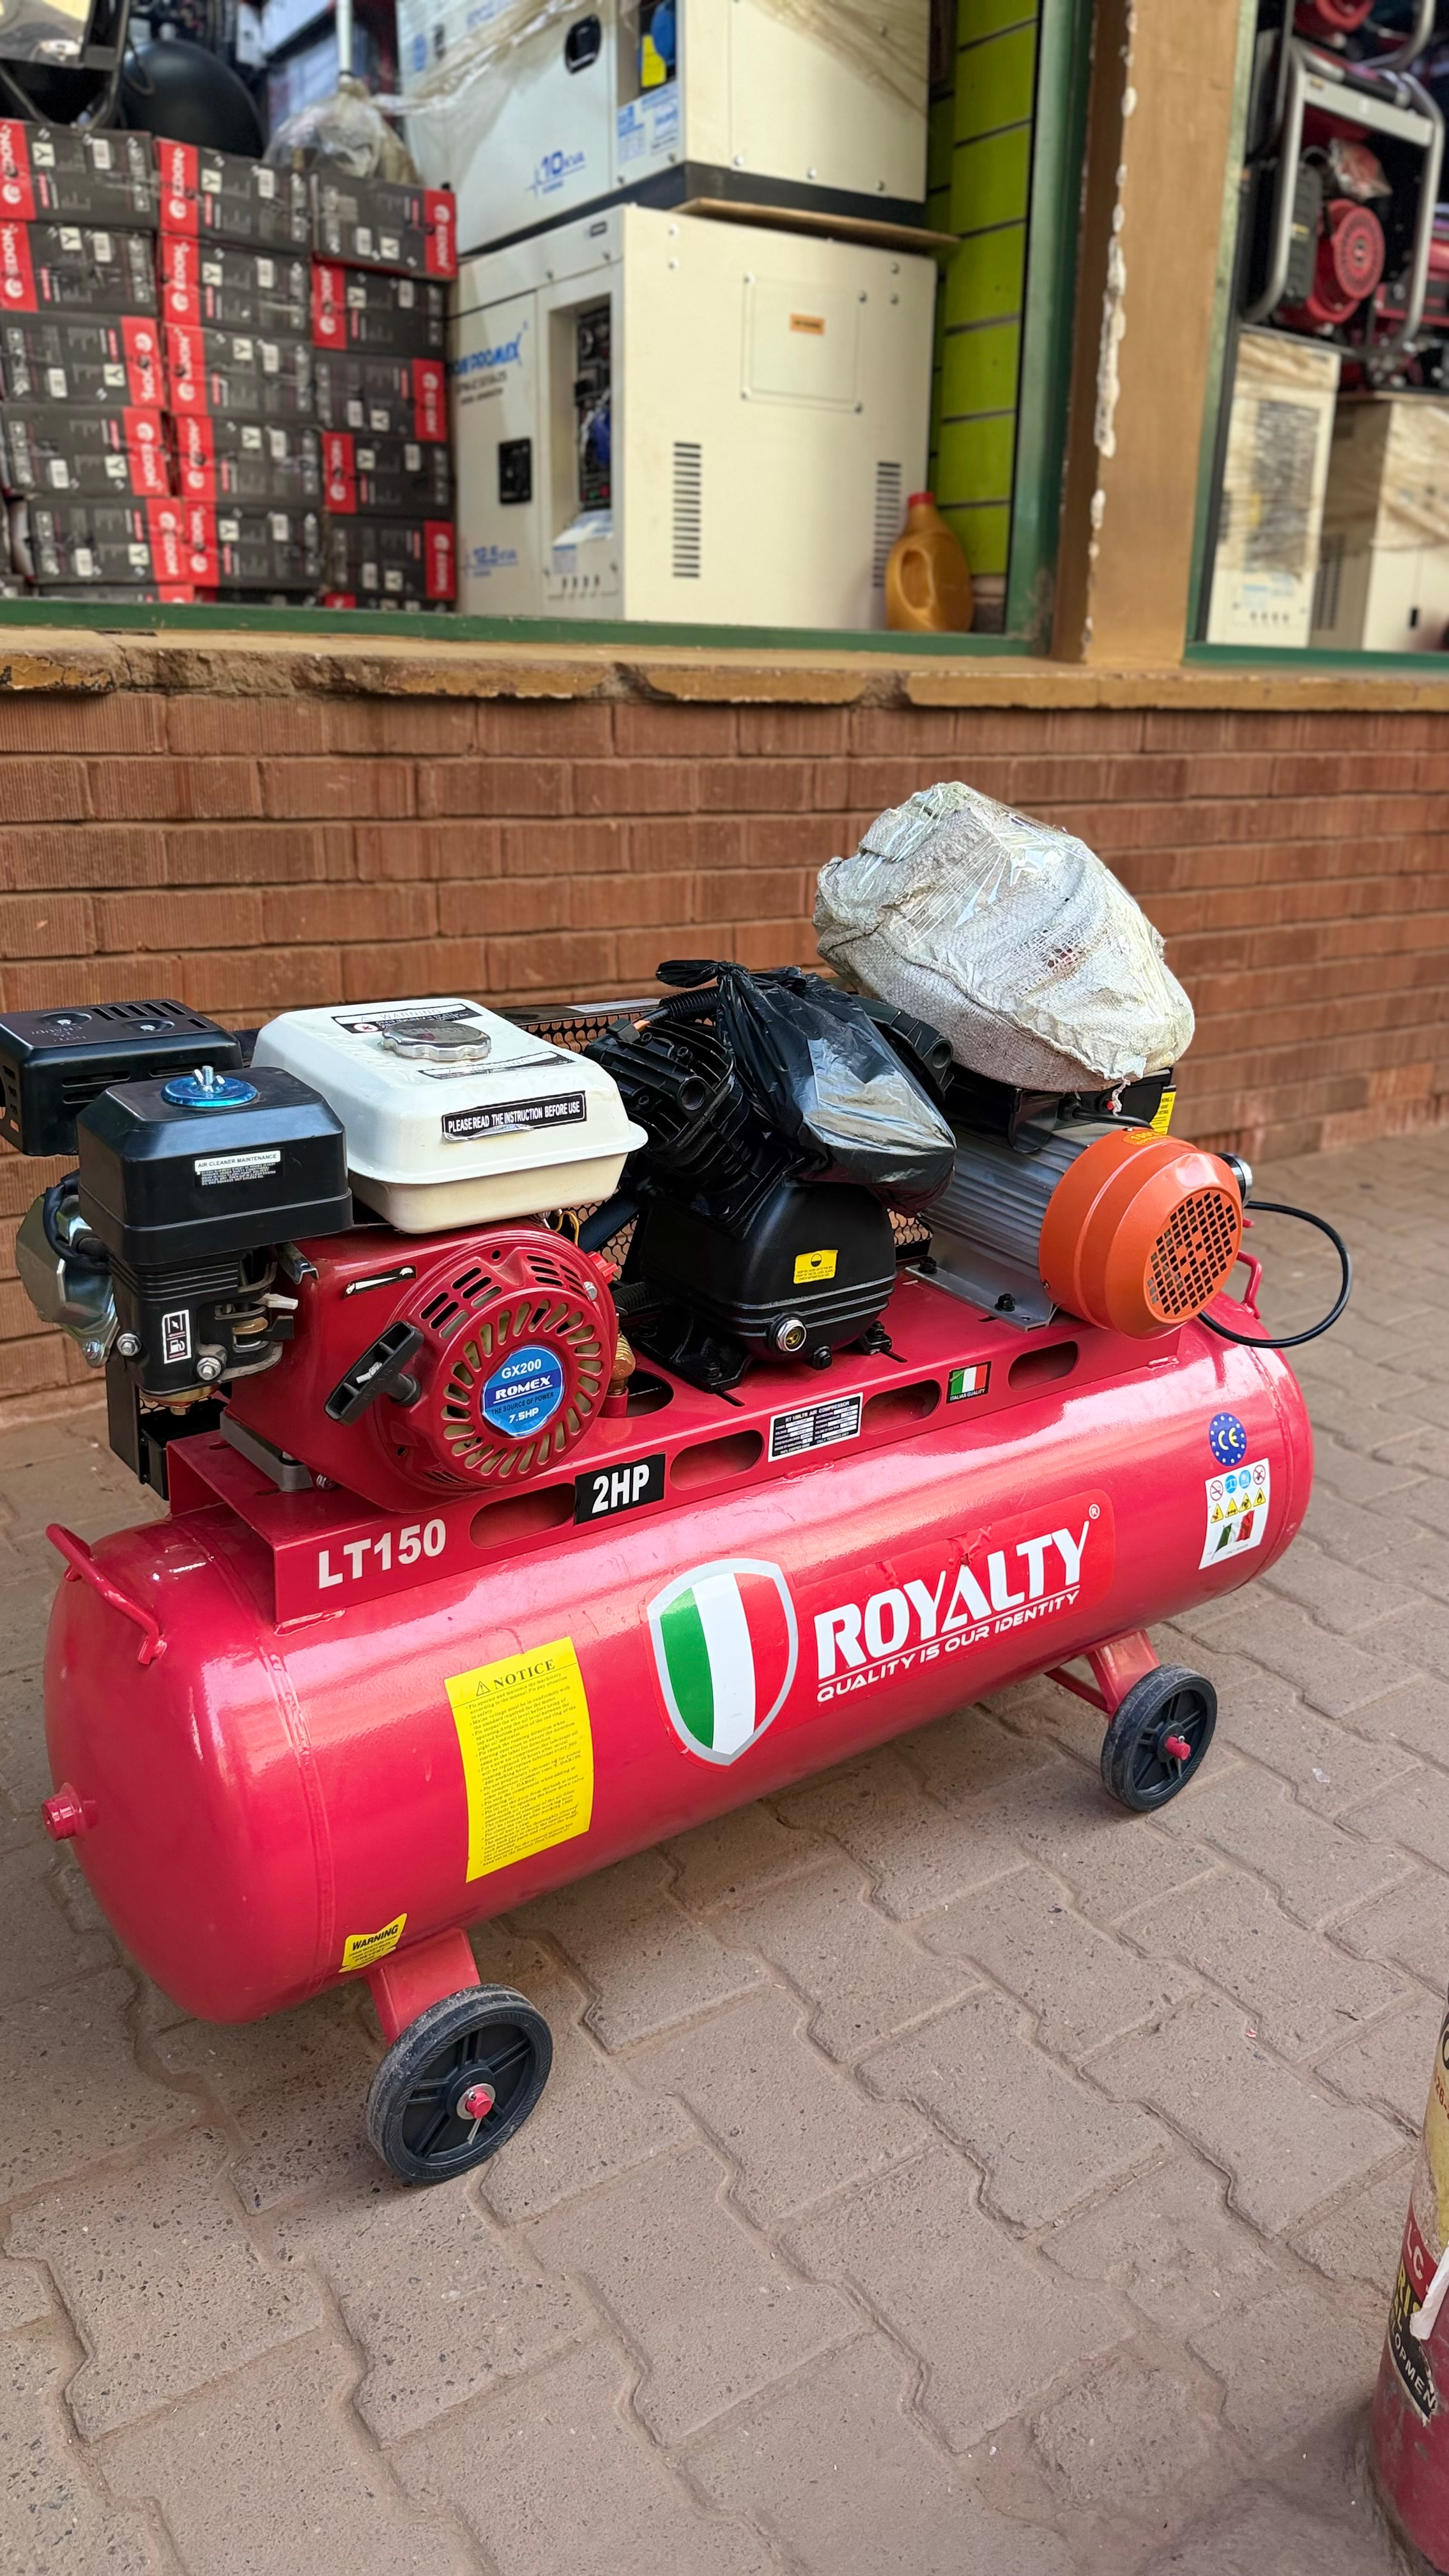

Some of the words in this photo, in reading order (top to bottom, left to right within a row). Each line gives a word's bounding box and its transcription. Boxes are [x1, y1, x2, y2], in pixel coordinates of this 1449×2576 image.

[379, 1008, 442, 1020] WARNING
[448, 1117, 472, 1133] PLEASE
[473, 1115, 489, 1129] READ
[491, 1112, 503, 1126] THE
[504, 1107, 543, 1124] INSTRUCTION
[544, 1103, 568, 1118] BEFORE
[569, 1101, 581, 1114] USE
[209, 1158, 236, 1167] CLEANER
[237, 1153, 277, 1163] MAINTENANCE
[501, 1358, 542, 1379] GX200
[495, 1375, 551, 1400] ROMEX
[491, 1407, 502, 1416] THE
[503, 1400, 526, 1413] SOURCE
[526, 1397, 534, 1406] OF
[534, 1392, 555, 1403] POWER
[509, 1407, 539, 1424] 7.5HP
[1218, 1430, 1240, 1450] CE
[592, 1464, 650, 1515] 2HP
[319, 1518, 446, 1590] LT150
[813, 1521, 1090, 1680] ROYALTY
[816, 1658, 917, 1703] QUALITY
[919, 1646, 940, 1662] IS
[946, 1625, 993, 1650] OUR
[994, 1590, 1081, 1634] IDENTITY
[493, 1659, 556, 1690] NOTICE
[352, 1924, 399, 1951] WARNING
